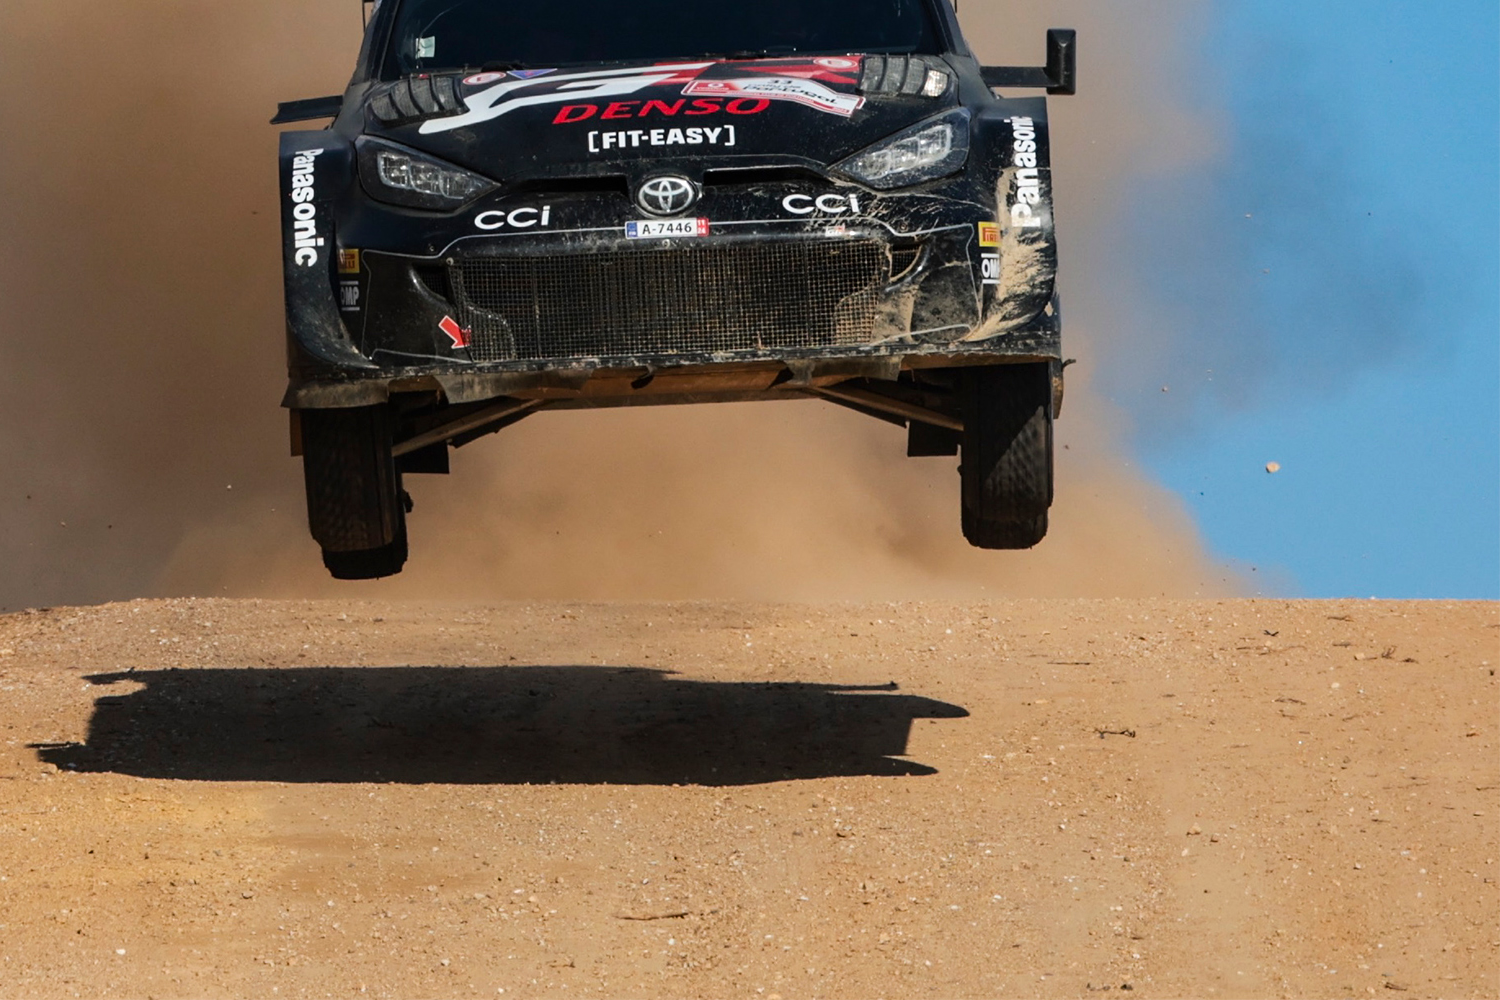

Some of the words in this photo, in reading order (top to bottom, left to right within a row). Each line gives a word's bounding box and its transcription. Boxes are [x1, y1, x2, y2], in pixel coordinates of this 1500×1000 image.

[551, 97, 771, 125] DENSO
[291, 148, 325, 268] Panasonic
[642, 221, 692, 235] A-7446
